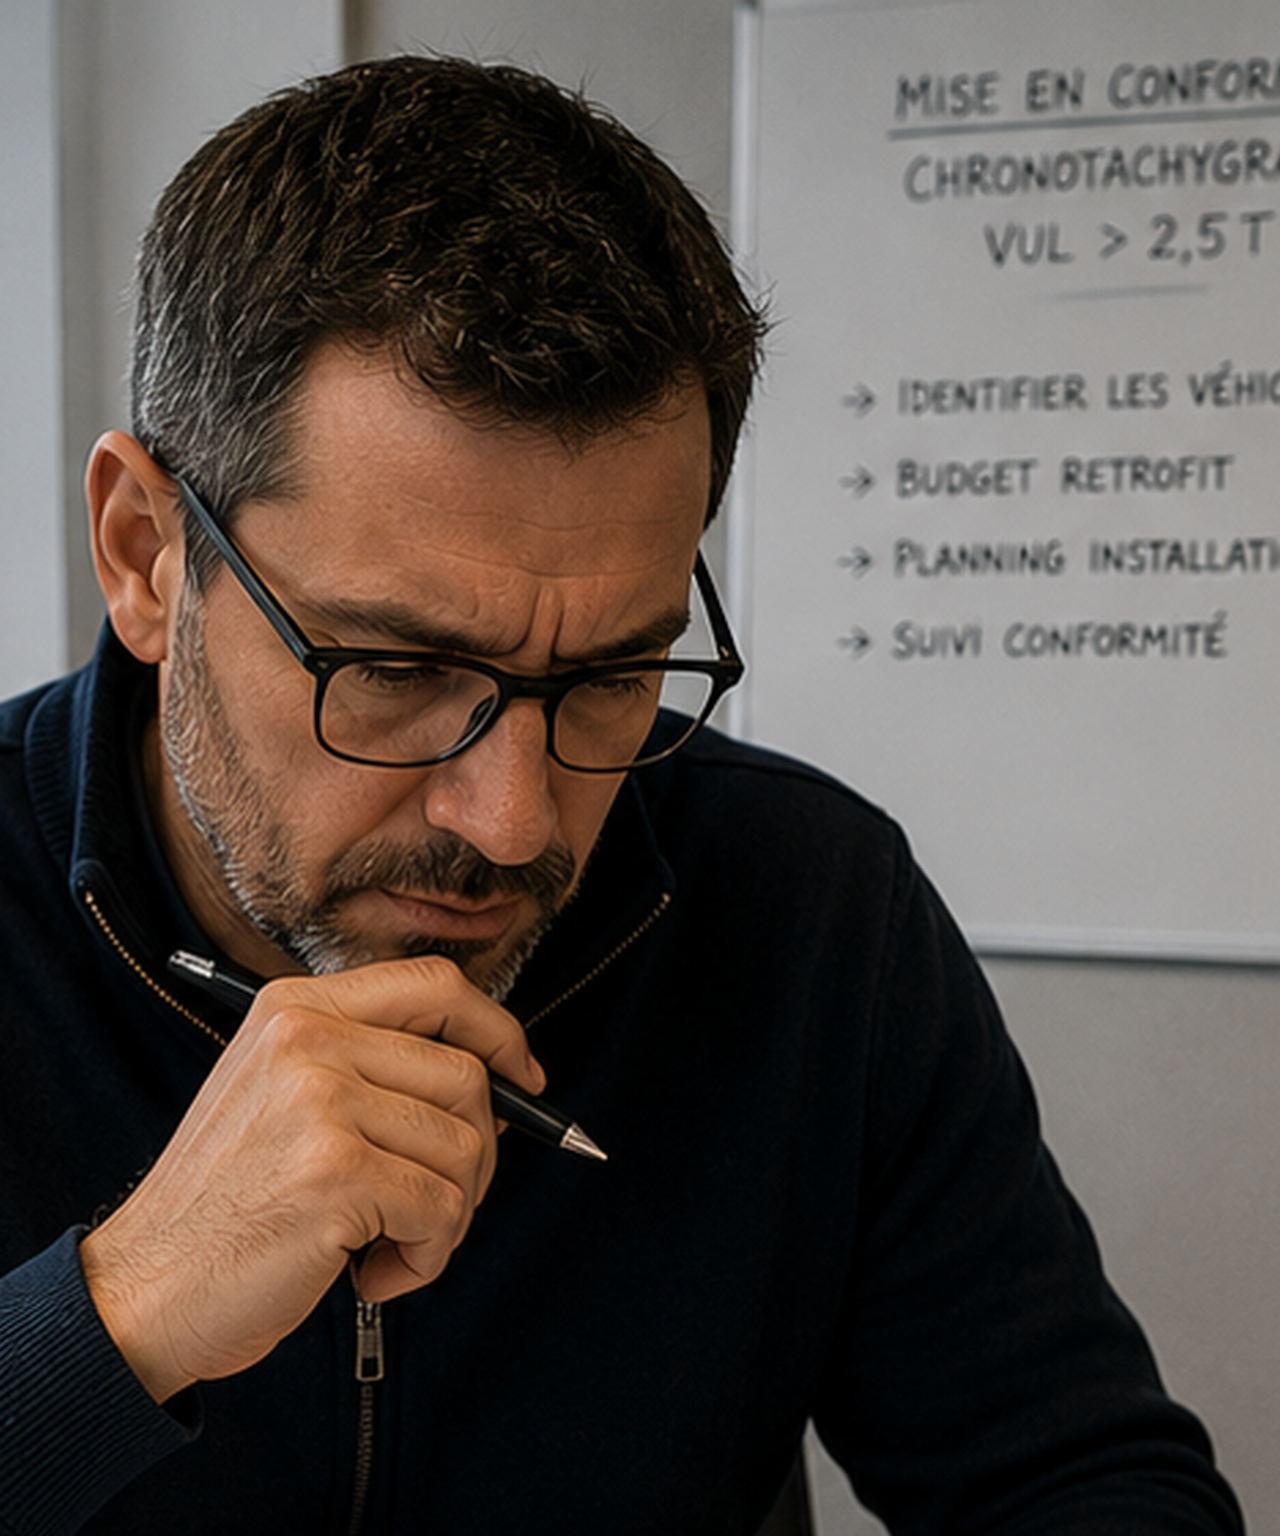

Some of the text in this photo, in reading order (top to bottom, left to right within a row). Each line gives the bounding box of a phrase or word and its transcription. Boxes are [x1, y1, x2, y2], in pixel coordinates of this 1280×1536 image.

[896, 72, 998, 118] MISE
[1026, 69, 1084, 113] EN
[984, 222, 1073, 268] VUL
[899, 374, 1088, 415] IDENTIFIER
[1107, 372, 1169, 410] LES
[897, 455, 1234, 498] BUDGET RETROFIT
[895, 540, 1066, 577] PLANNING
[892, 610, 1227, 660] SUIVI CONFORMITÉ
